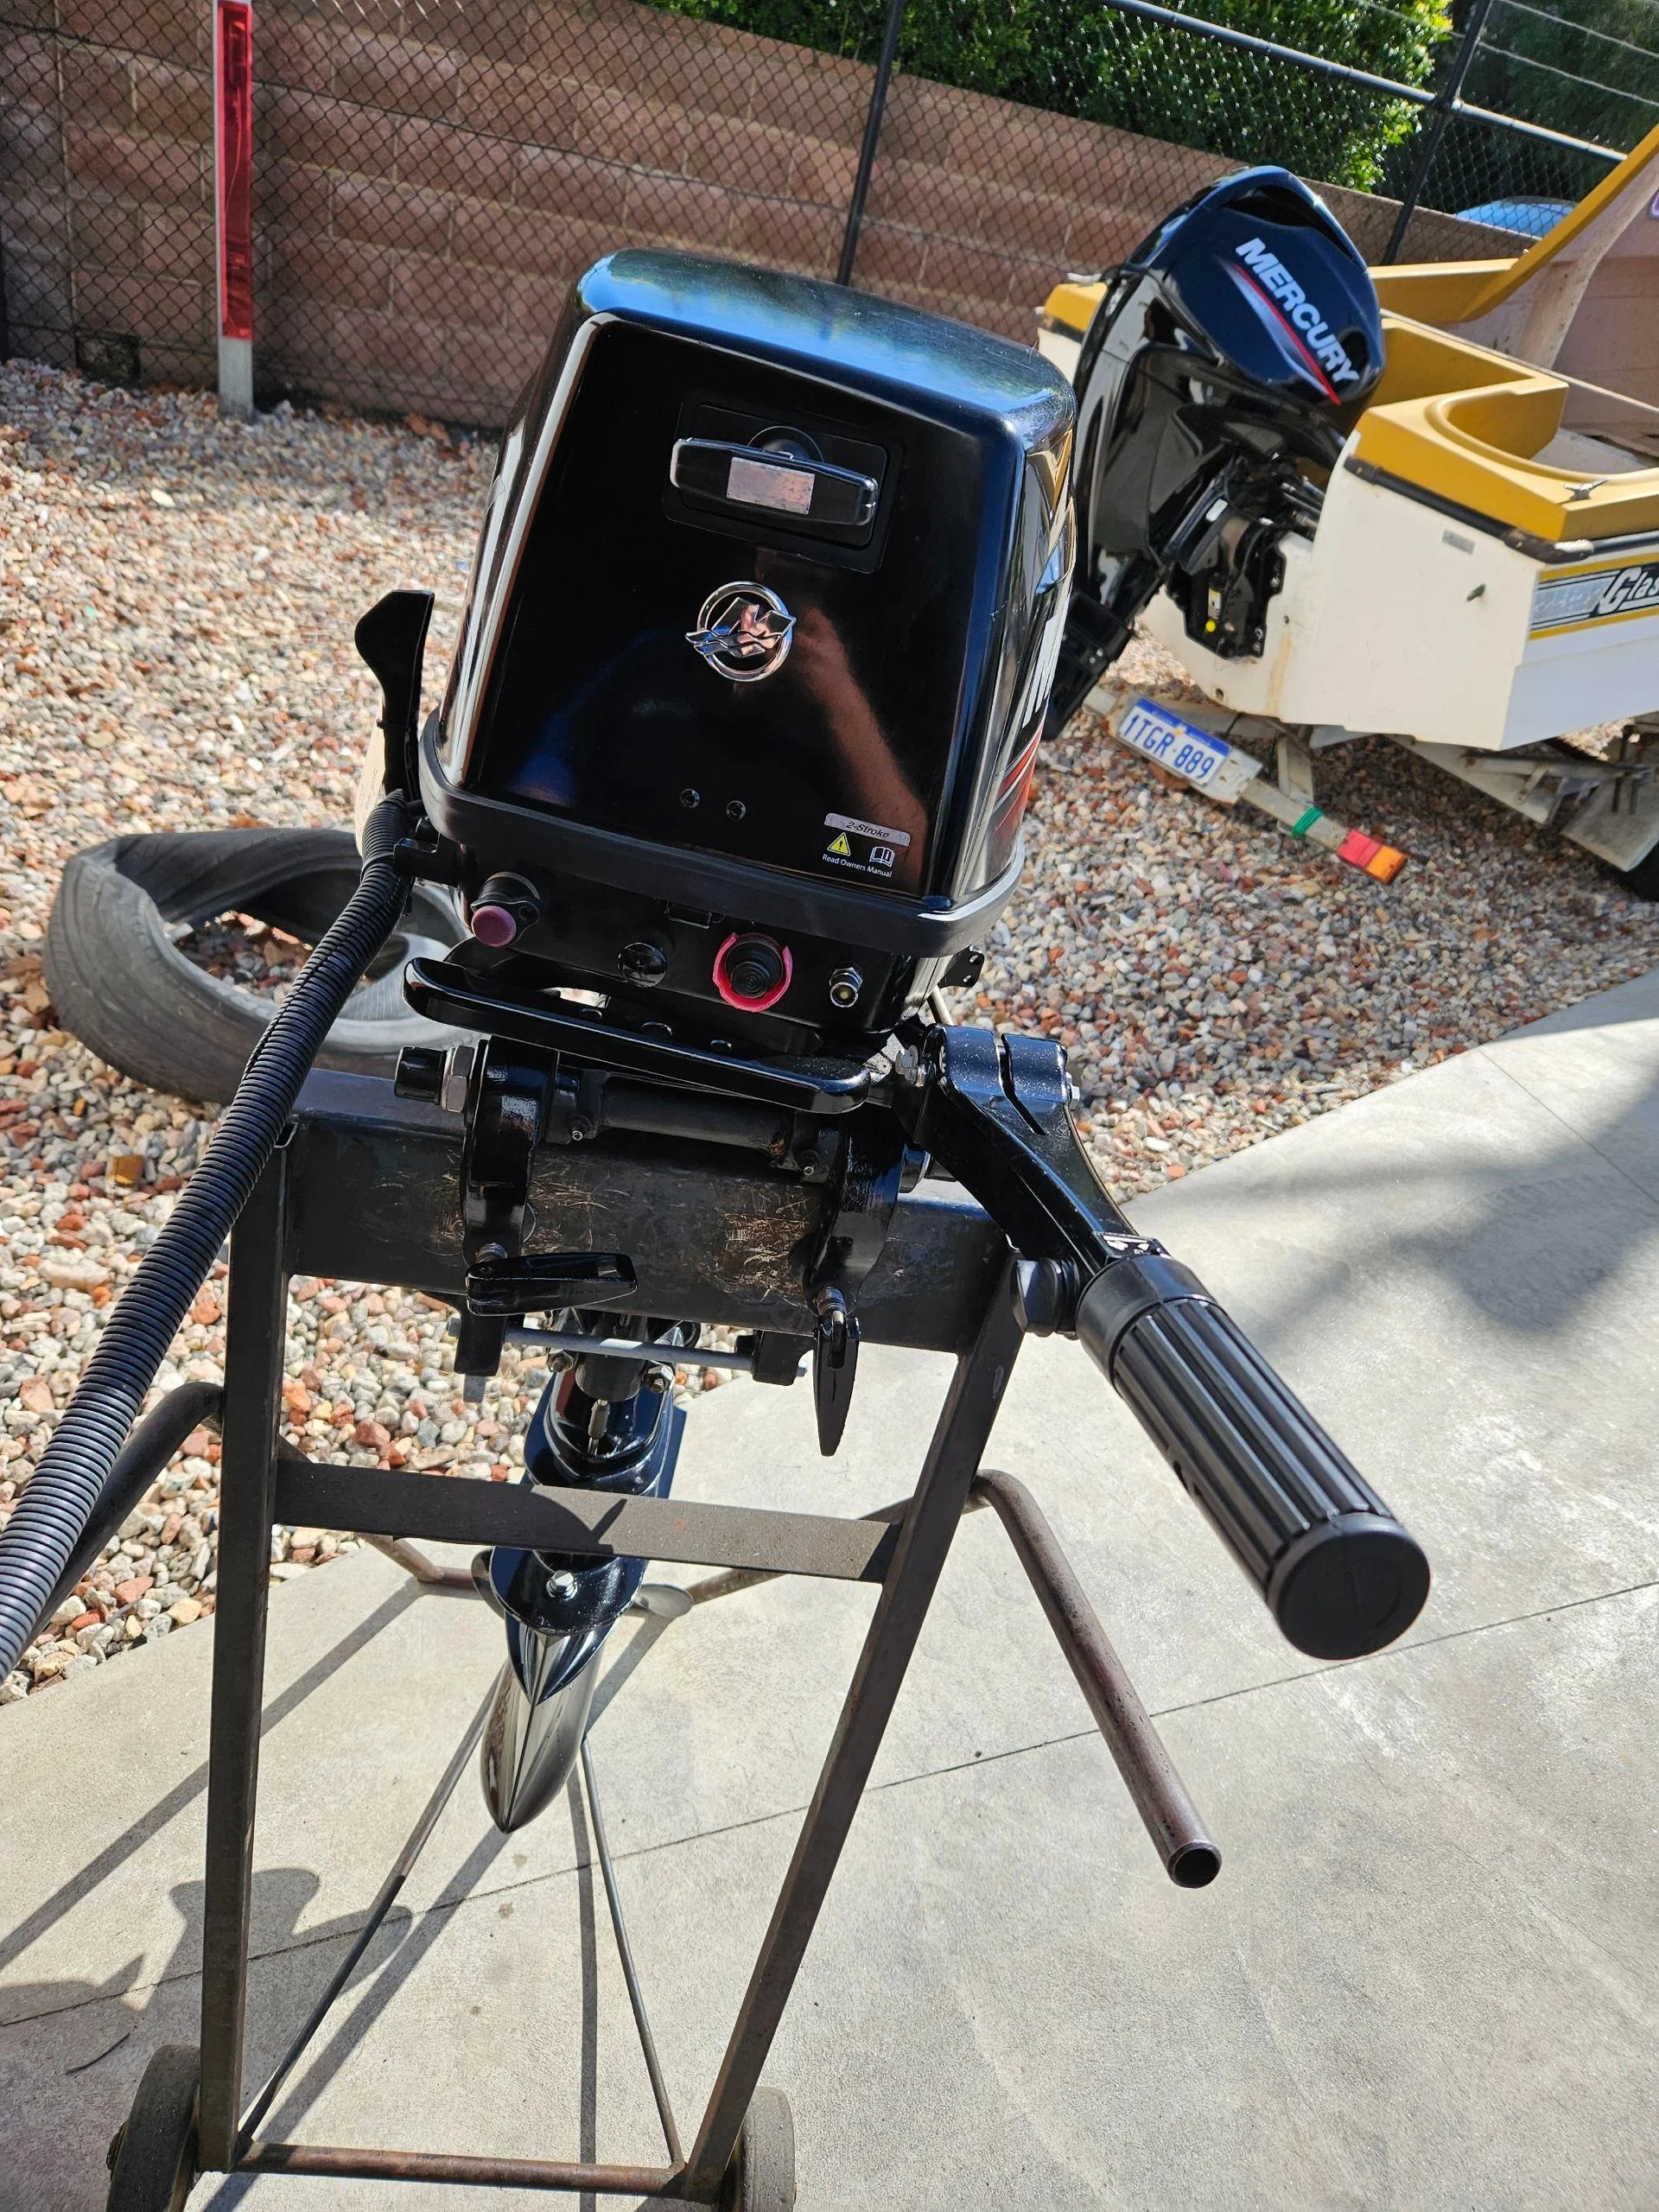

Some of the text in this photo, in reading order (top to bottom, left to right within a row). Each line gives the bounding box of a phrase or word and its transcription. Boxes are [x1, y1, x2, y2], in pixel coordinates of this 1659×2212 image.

[1236, 238, 1359, 383] MERCURY
[846, 821, 890, 838] 2-Stroke
[823, 854, 893, 878] Read Owners Manual
